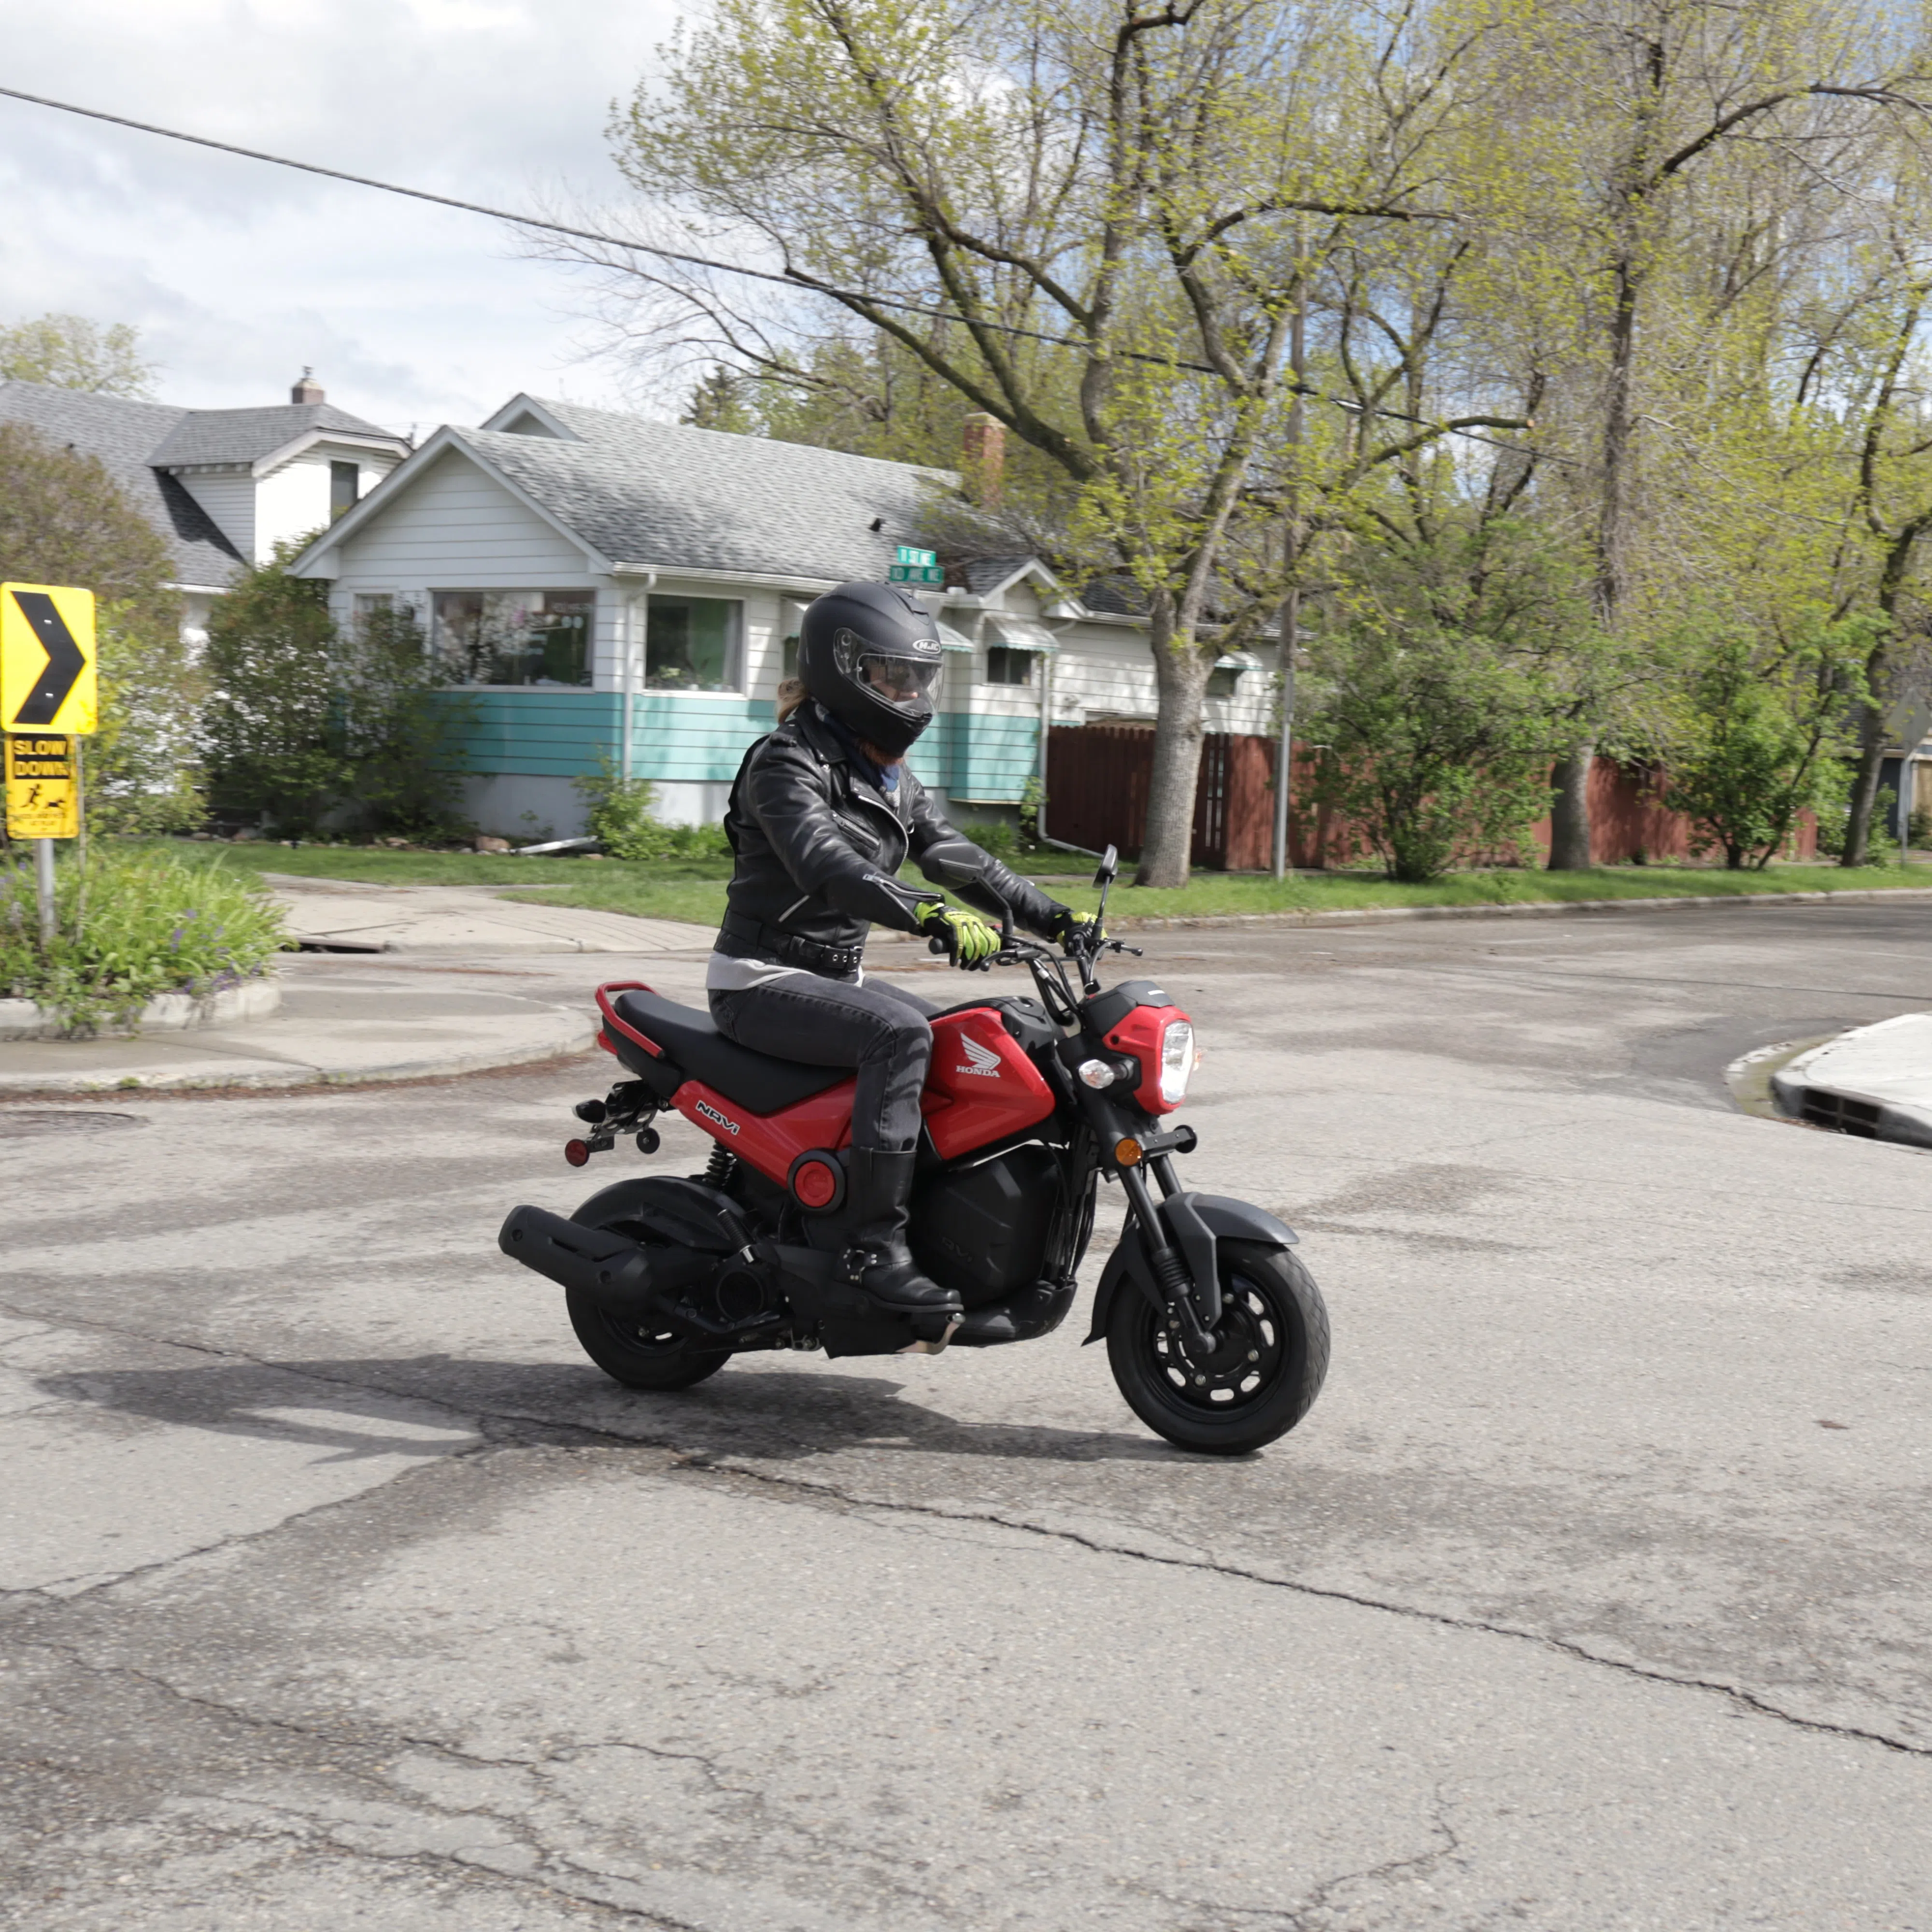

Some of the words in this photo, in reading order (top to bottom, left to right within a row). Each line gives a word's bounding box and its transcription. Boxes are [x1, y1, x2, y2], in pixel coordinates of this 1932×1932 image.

[919, 641, 939, 651] HJC
[14, 740, 67, 755] SLOW
[14, 761, 69, 776] DOWN
[956, 1065, 1000, 1078] HONDA
